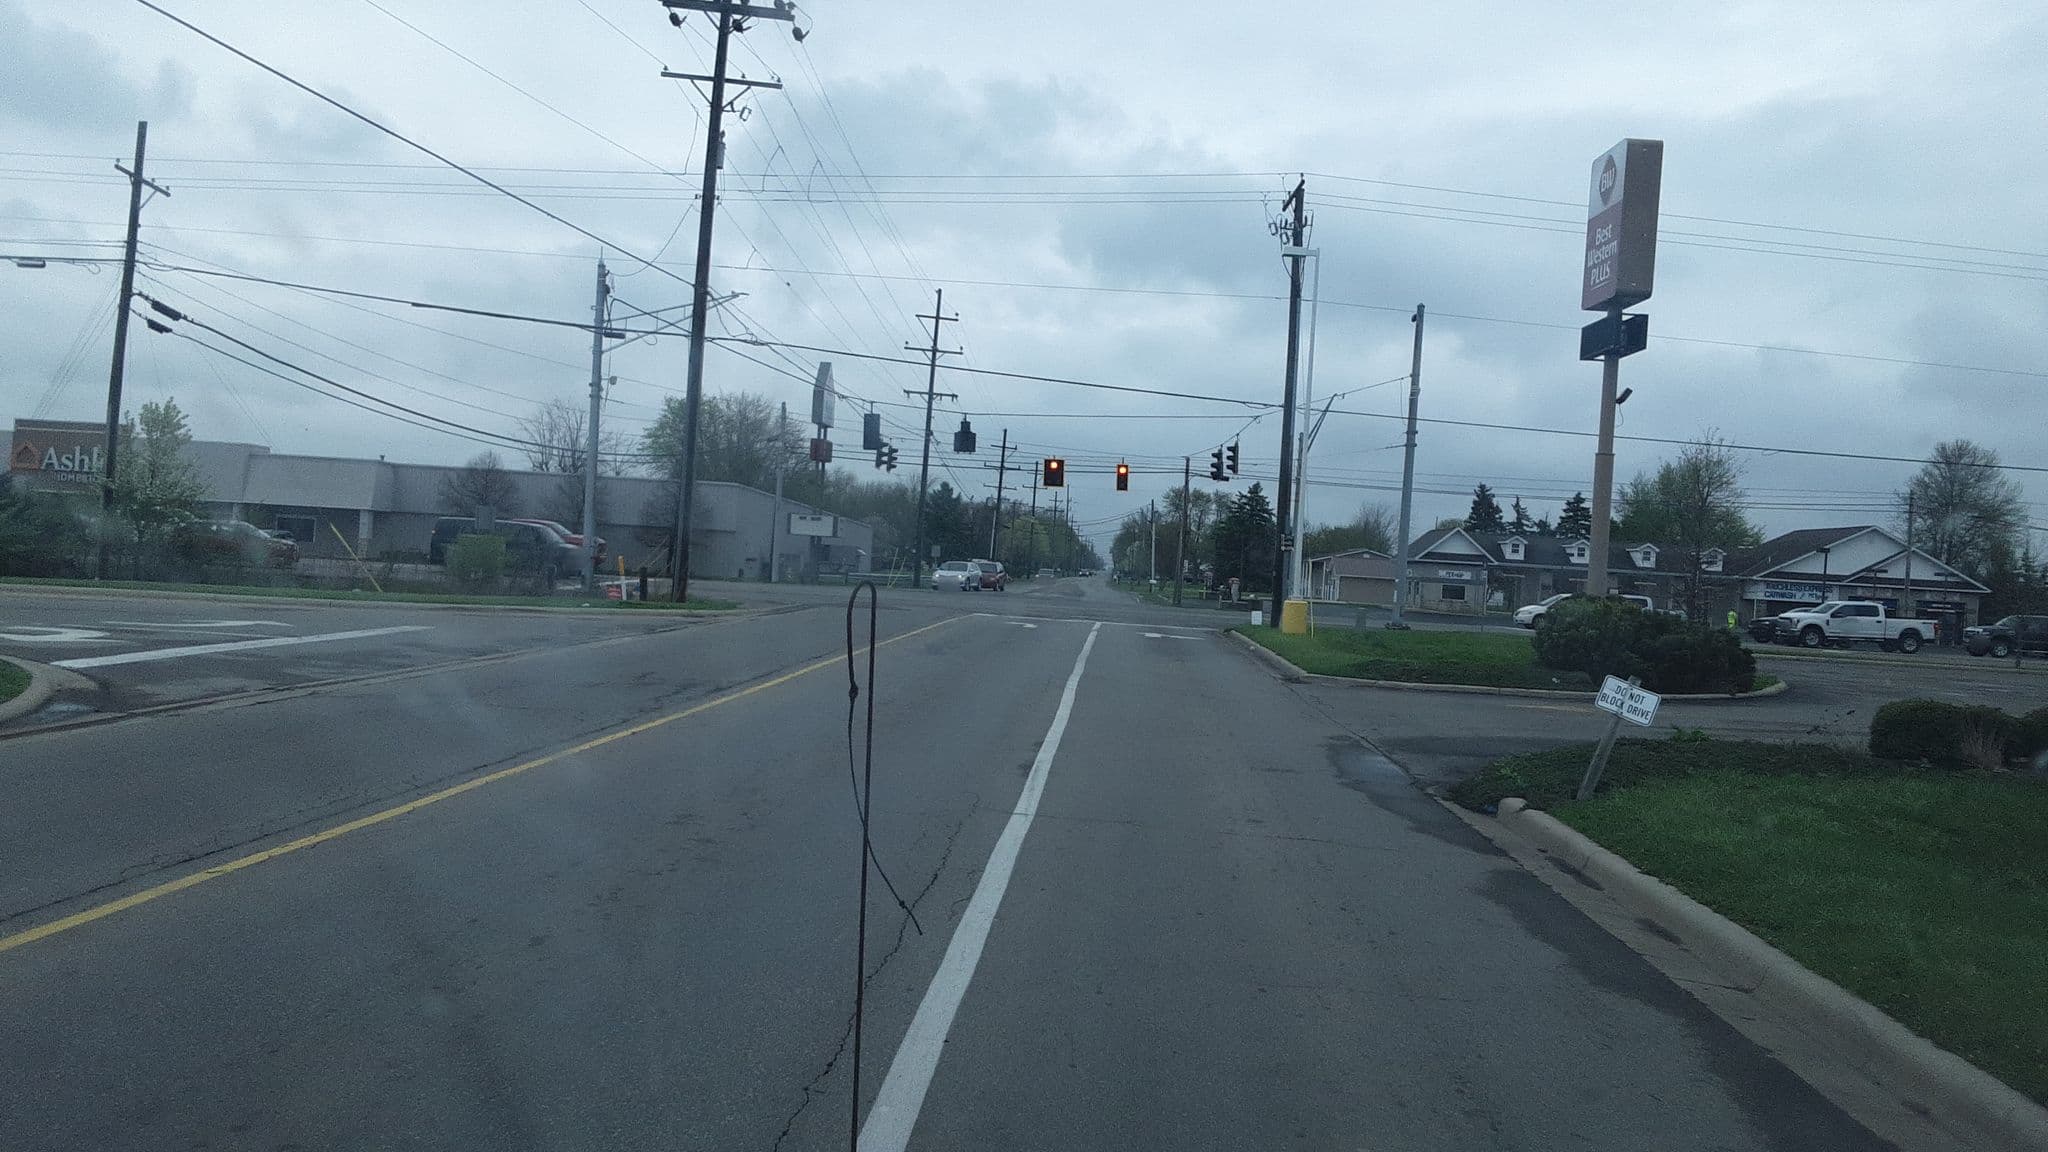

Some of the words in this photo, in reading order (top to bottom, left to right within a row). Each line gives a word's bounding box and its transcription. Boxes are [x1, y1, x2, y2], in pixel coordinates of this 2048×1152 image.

[1595, 223, 1612, 246] Best
[1587, 240, 1617, 268] Western
[1590, 261, 1611, 286] PLUS
[1600, 692, 1625, 711] BLOCK
[1626, 704, 1652, 721] DRIVE
[1614, 685, 1626, 697] DO
[1627, 692, 1646, 705] NOT
